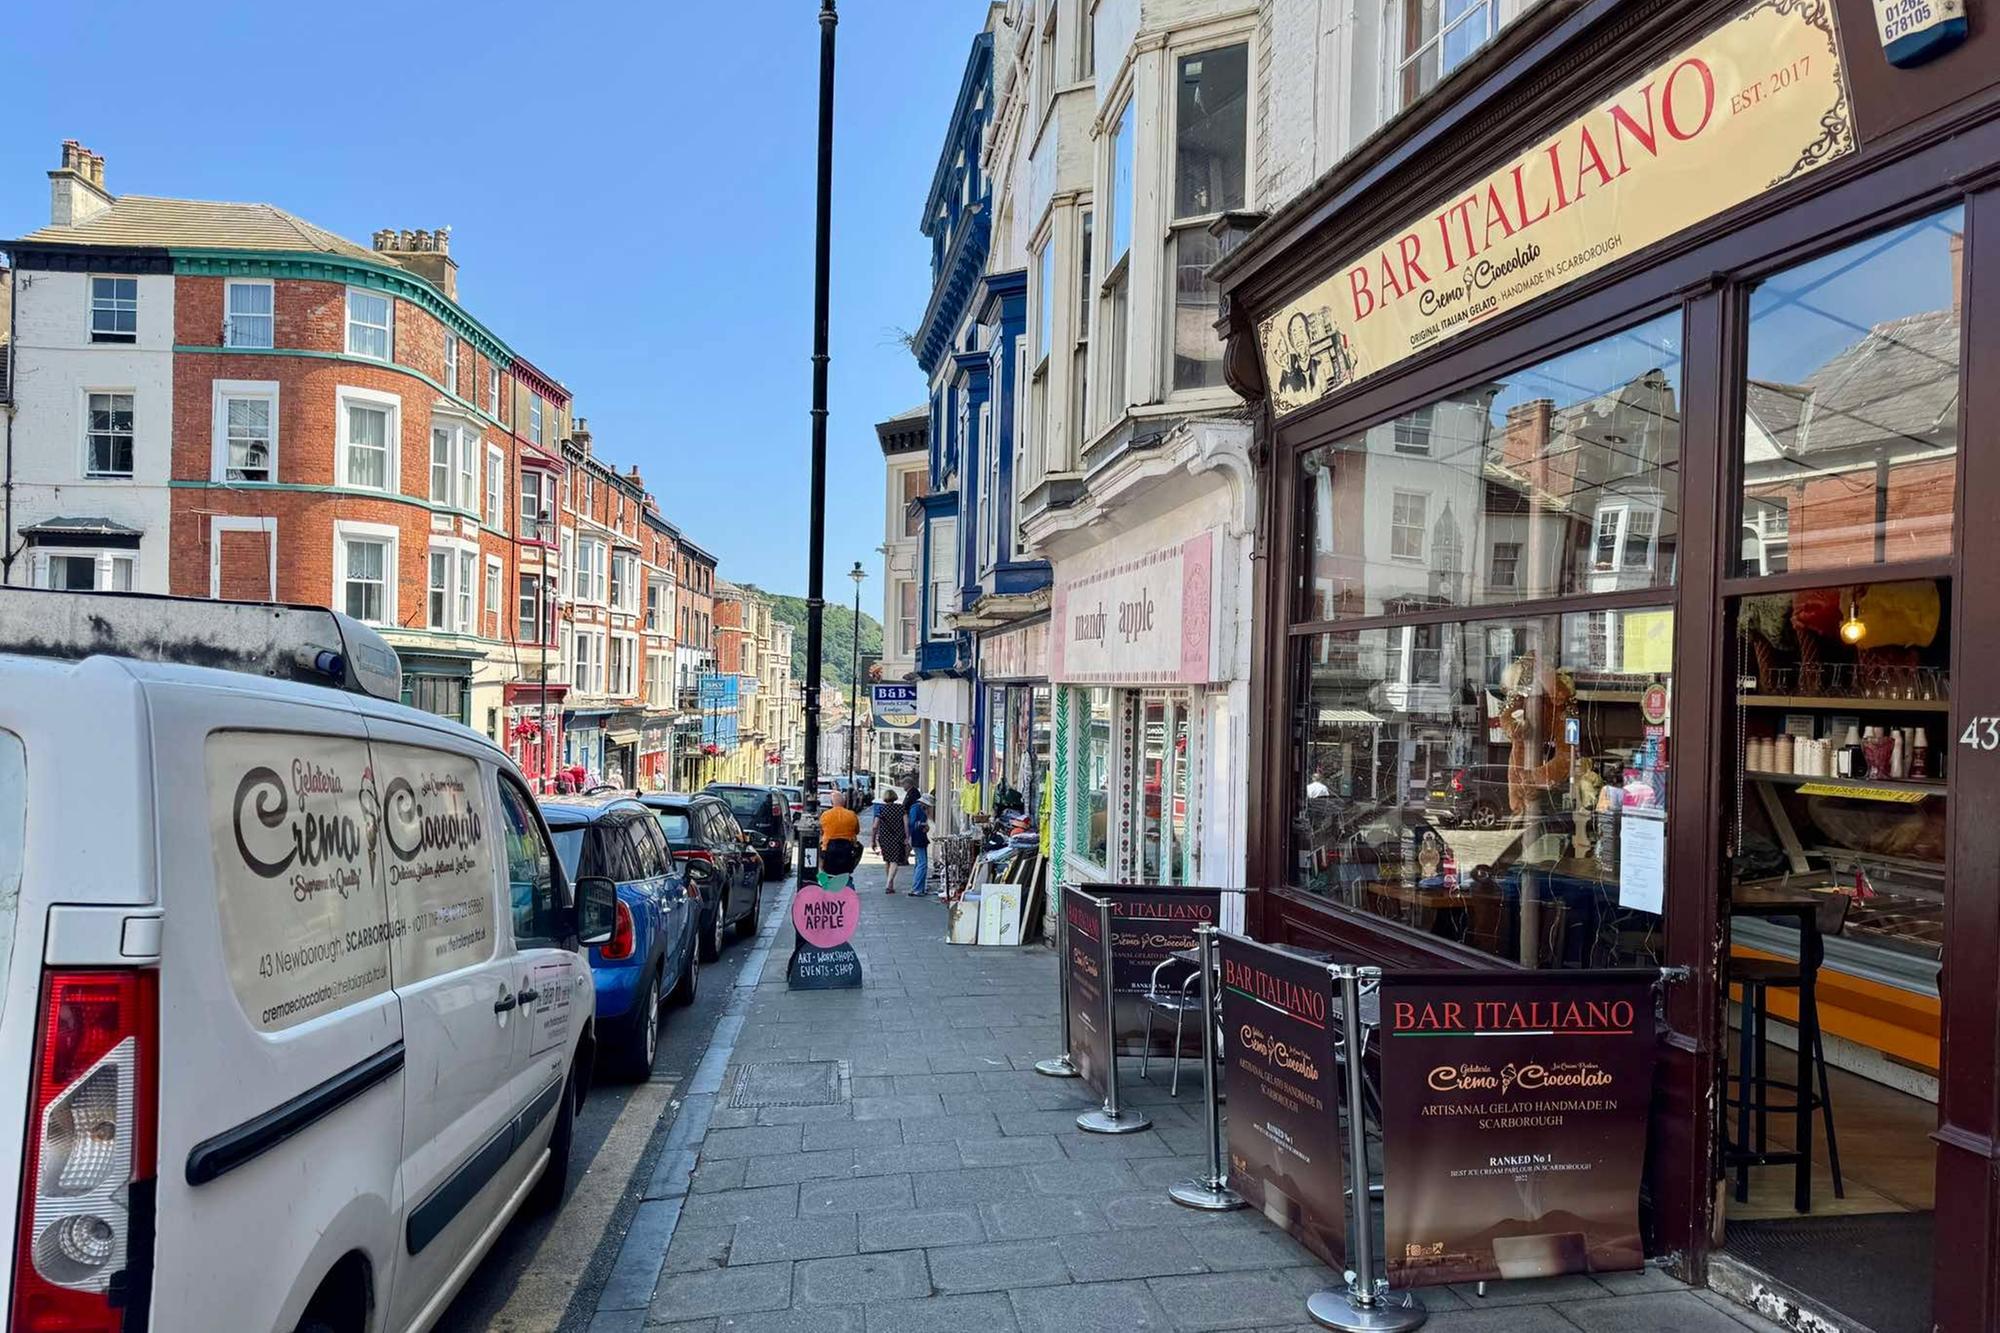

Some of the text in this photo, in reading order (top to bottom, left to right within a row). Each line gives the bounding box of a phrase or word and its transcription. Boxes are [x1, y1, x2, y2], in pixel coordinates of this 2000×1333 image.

[1885, 4, 1931, 39] 678105
[1731, 56, 1811, 115] EST. 2017
[1347, 58, 1715, 322] BAR ITALIANO
[1410, 234, 1622, 345] ORIGINAL ITALIAN GELATO HANDMADE IN SCARBOROUGH
[1419, 243, 1540, 316] Crema Cioccolato
[1075, 588, 1154, 648] mandy apple
[879, 688, 907, 698] B&B
[1959, 716, 1999, 750] 43
[292, 758, 343, 813] Gelateria
[233, 766, 481, 878] Crema Cioccolato
[804, 901, 845, 915] MANDY
[805, 915, 844, 929] APPLE
[1129, 903, 1212, 919] ITALIANO
[260, 953, 273, 978] 43
[345, 918, 406, 952] SCARBOROUGH
[798, 951, 854, 963] ART WORKSHOPS
[801, 963, 853, 977] EVENTS SHOP
[1226, 959, 1325, 1021] BAR ITALIANO
[1393, 1000, 1634, 1030] BAR ITALIANO
[1275, 1042, 1319, 1080] Cioccolato
[1428, 1065, 1612, 1091] Crema Cioccolato
[1421, 1100, 1617, 1116] ARTISANAL GELATO HANDMADE IN
[1479, 1115, 1563, 1129] SCARBOROUGH
[1480, 1168, 1503, 1176] CREAM
[1490, 1153, 1552, 1167] RANKED No 1
